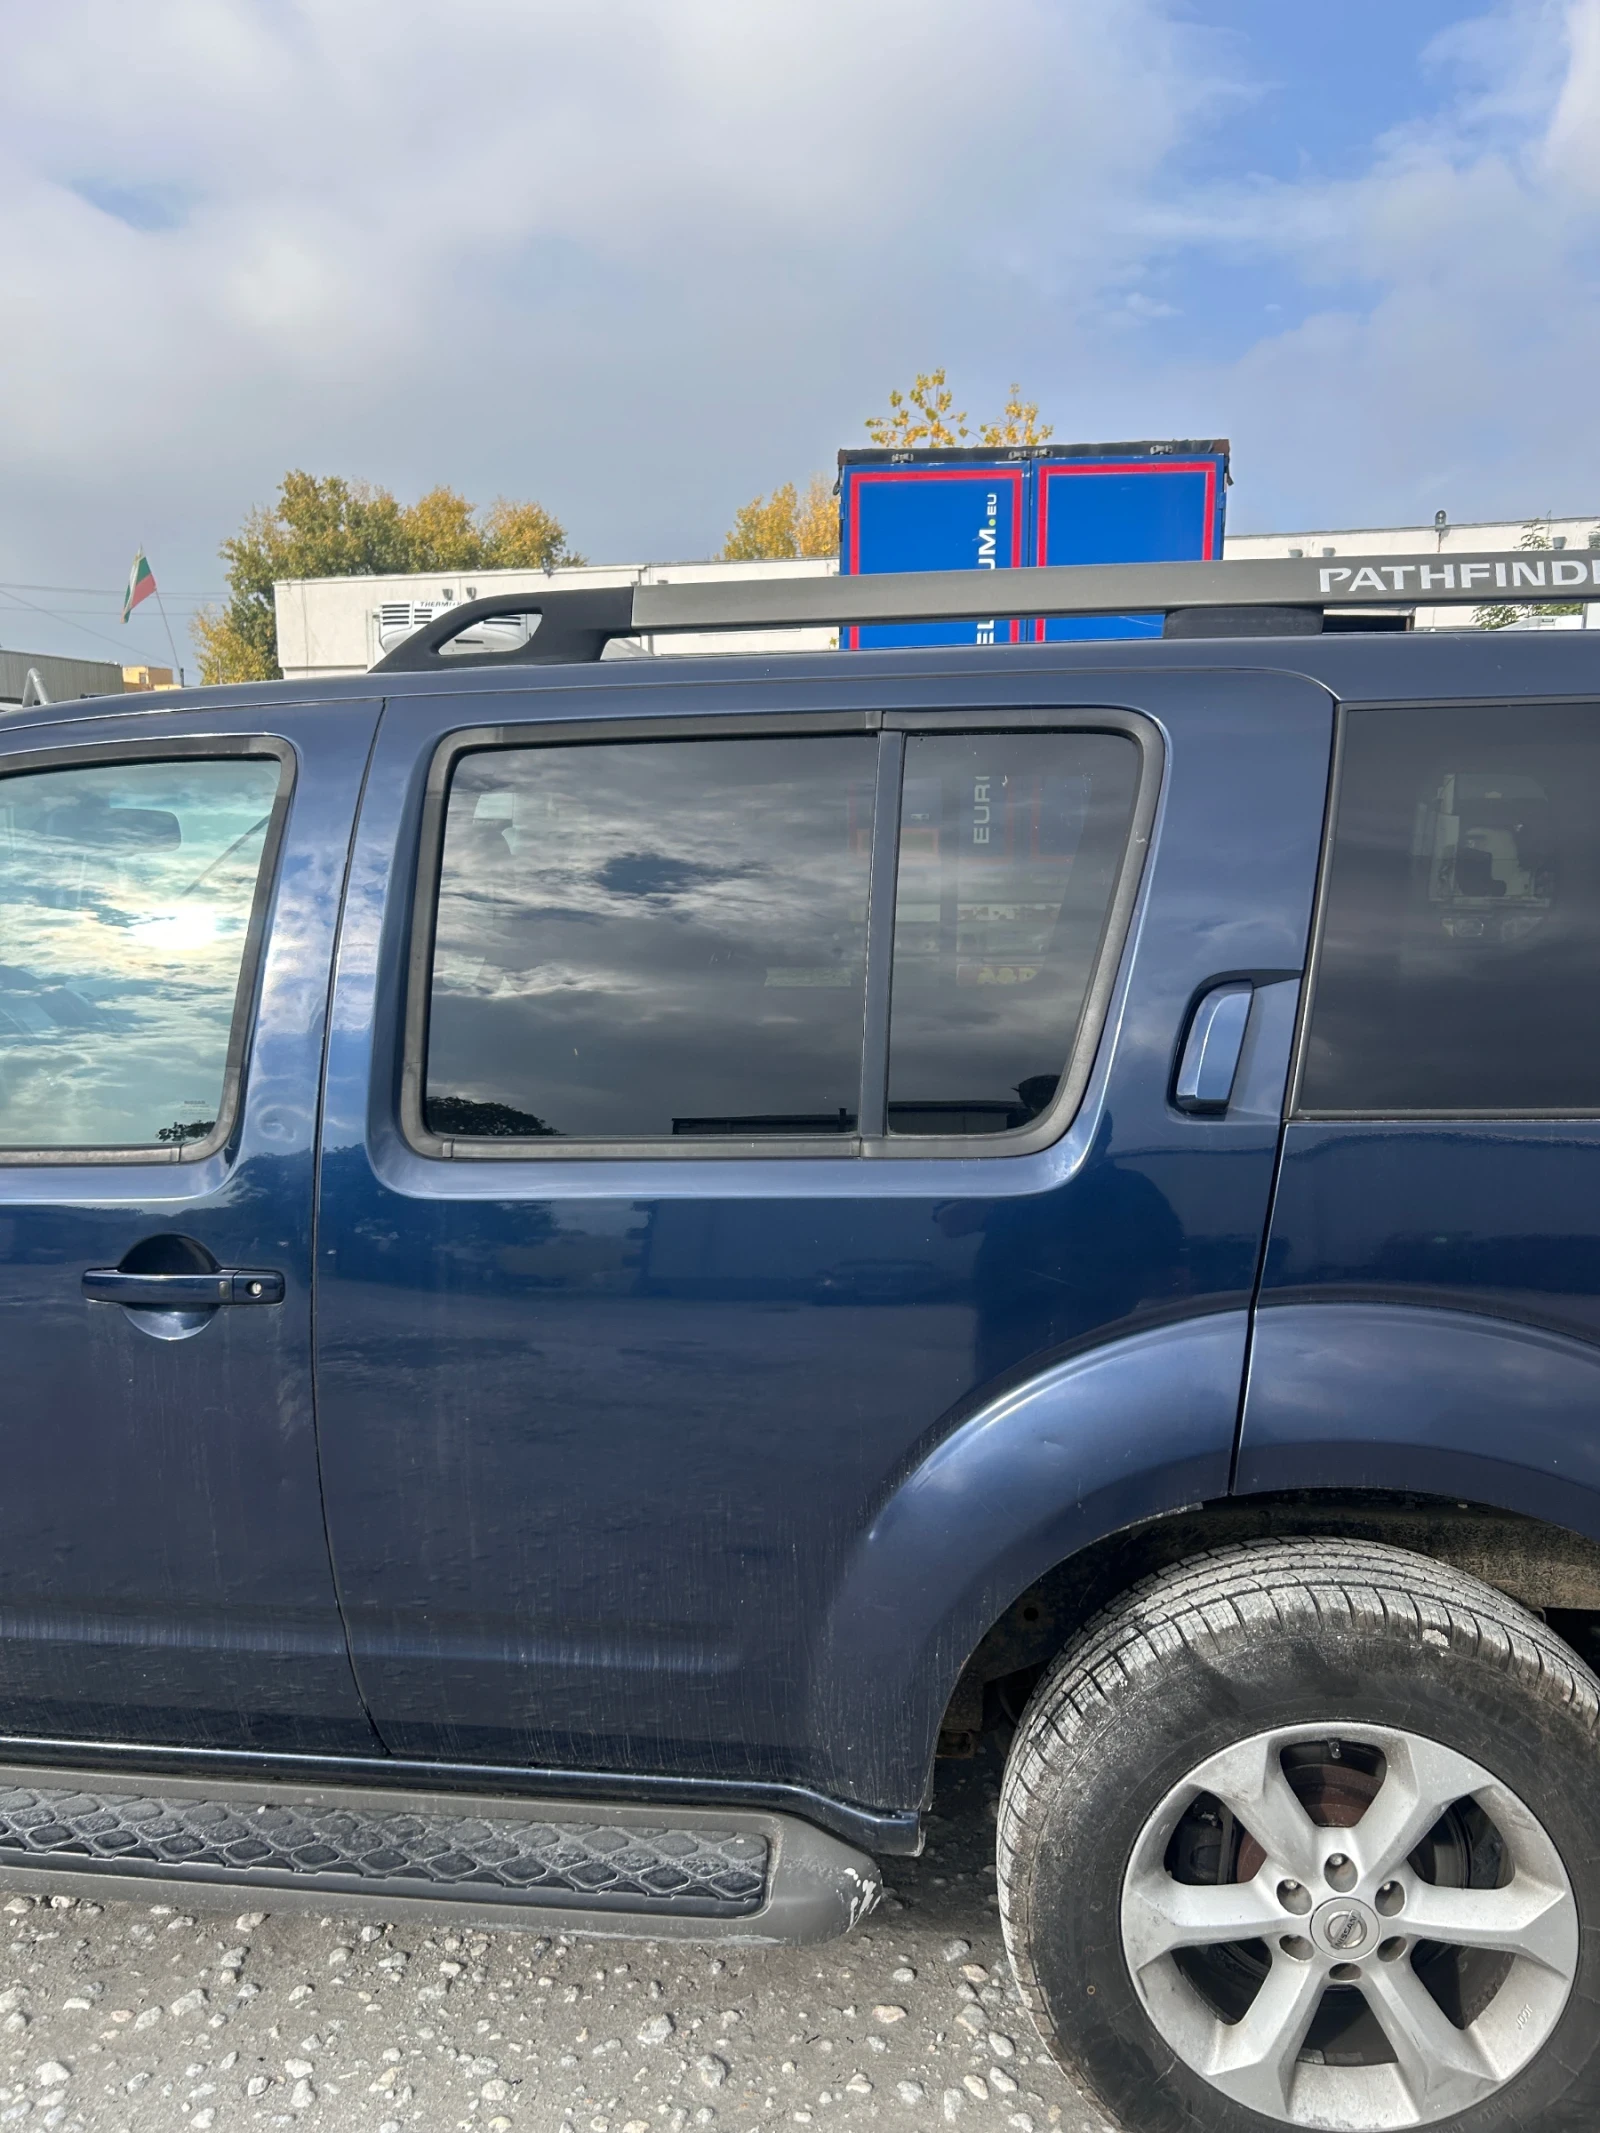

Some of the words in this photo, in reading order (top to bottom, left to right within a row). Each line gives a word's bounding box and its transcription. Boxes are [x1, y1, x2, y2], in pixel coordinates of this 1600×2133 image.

[1319, 560, 1600, 593] PATHFIND
[973, 776, 990, 844] EUR
[1335, 1915, 1357, 1947] NISSAN
